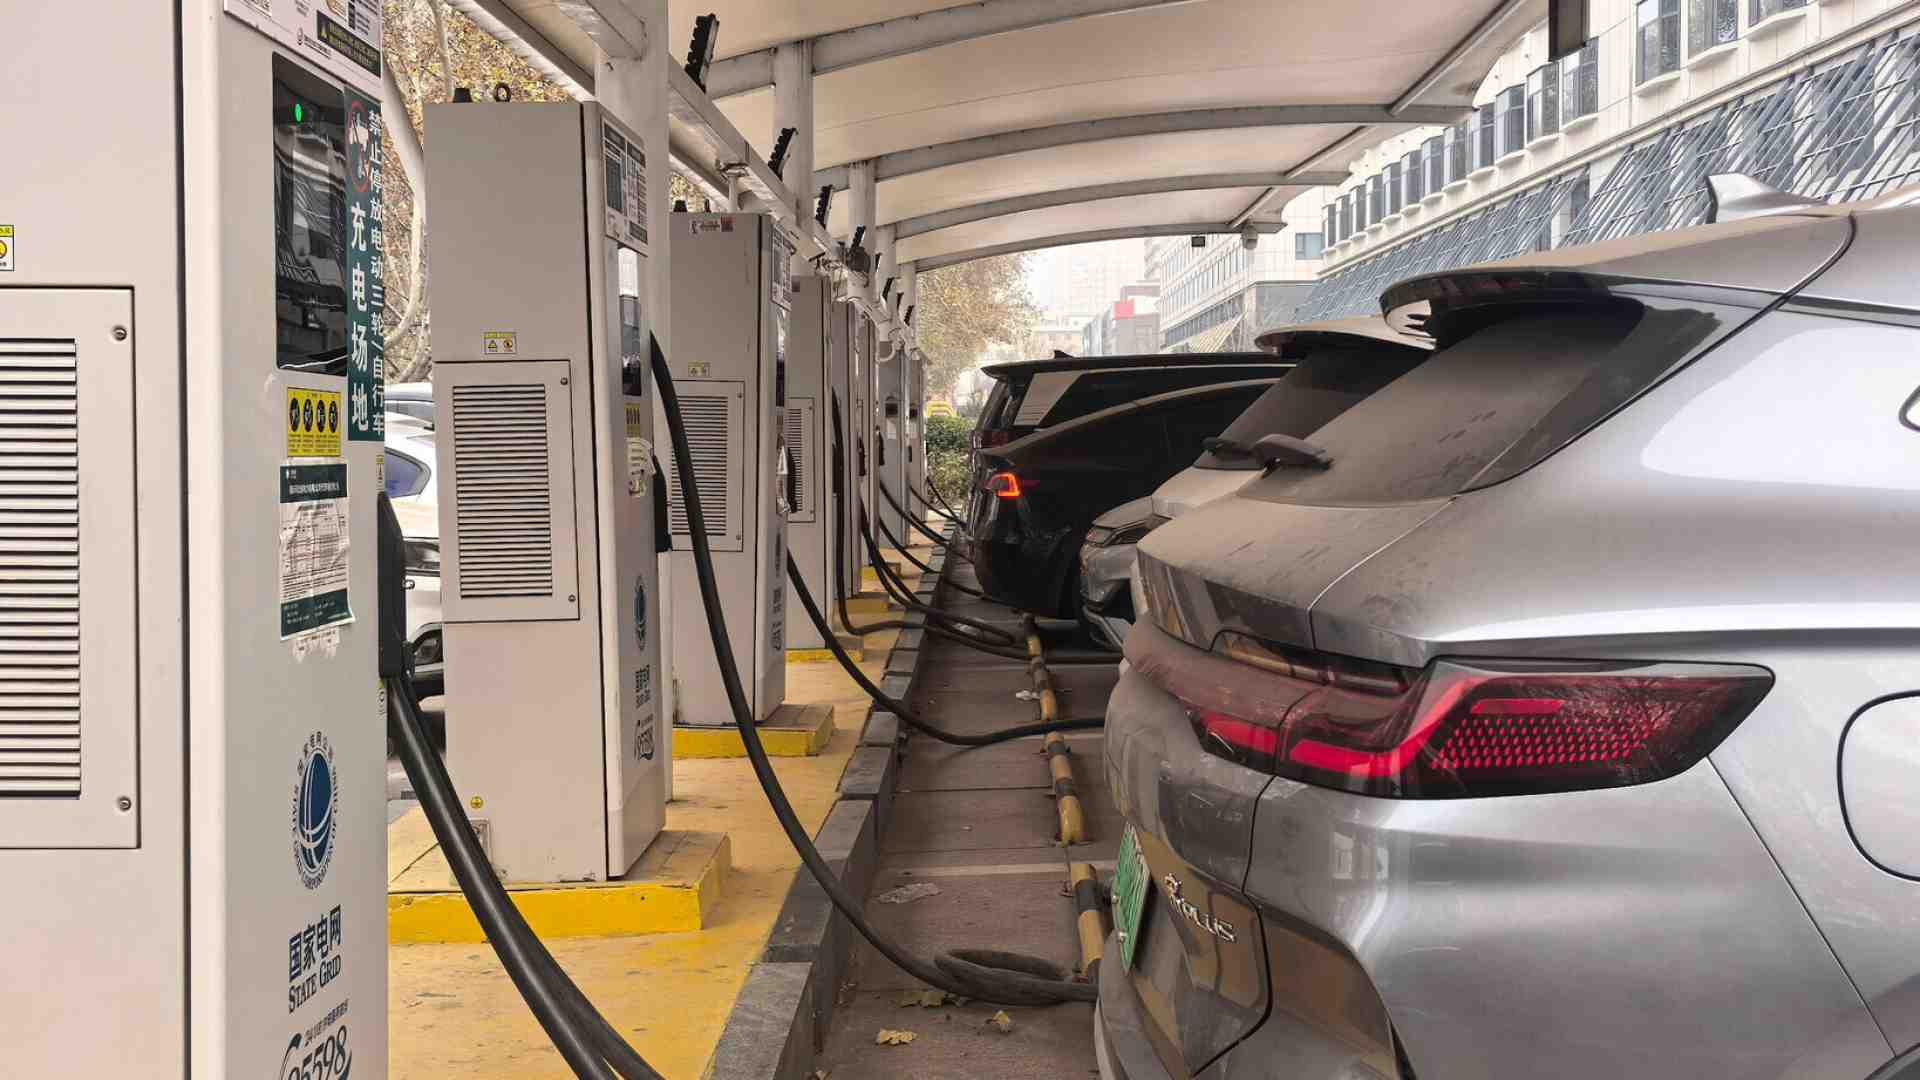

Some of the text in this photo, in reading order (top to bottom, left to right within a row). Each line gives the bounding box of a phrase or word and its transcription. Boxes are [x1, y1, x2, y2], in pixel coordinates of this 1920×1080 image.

[351, 201, 368, 430] 充电场地
[289, 904, 342, 983] 国家电网
[288, 954, 342, 1015] STATE GRID
[287, 1024, 347, 1080] 5598
